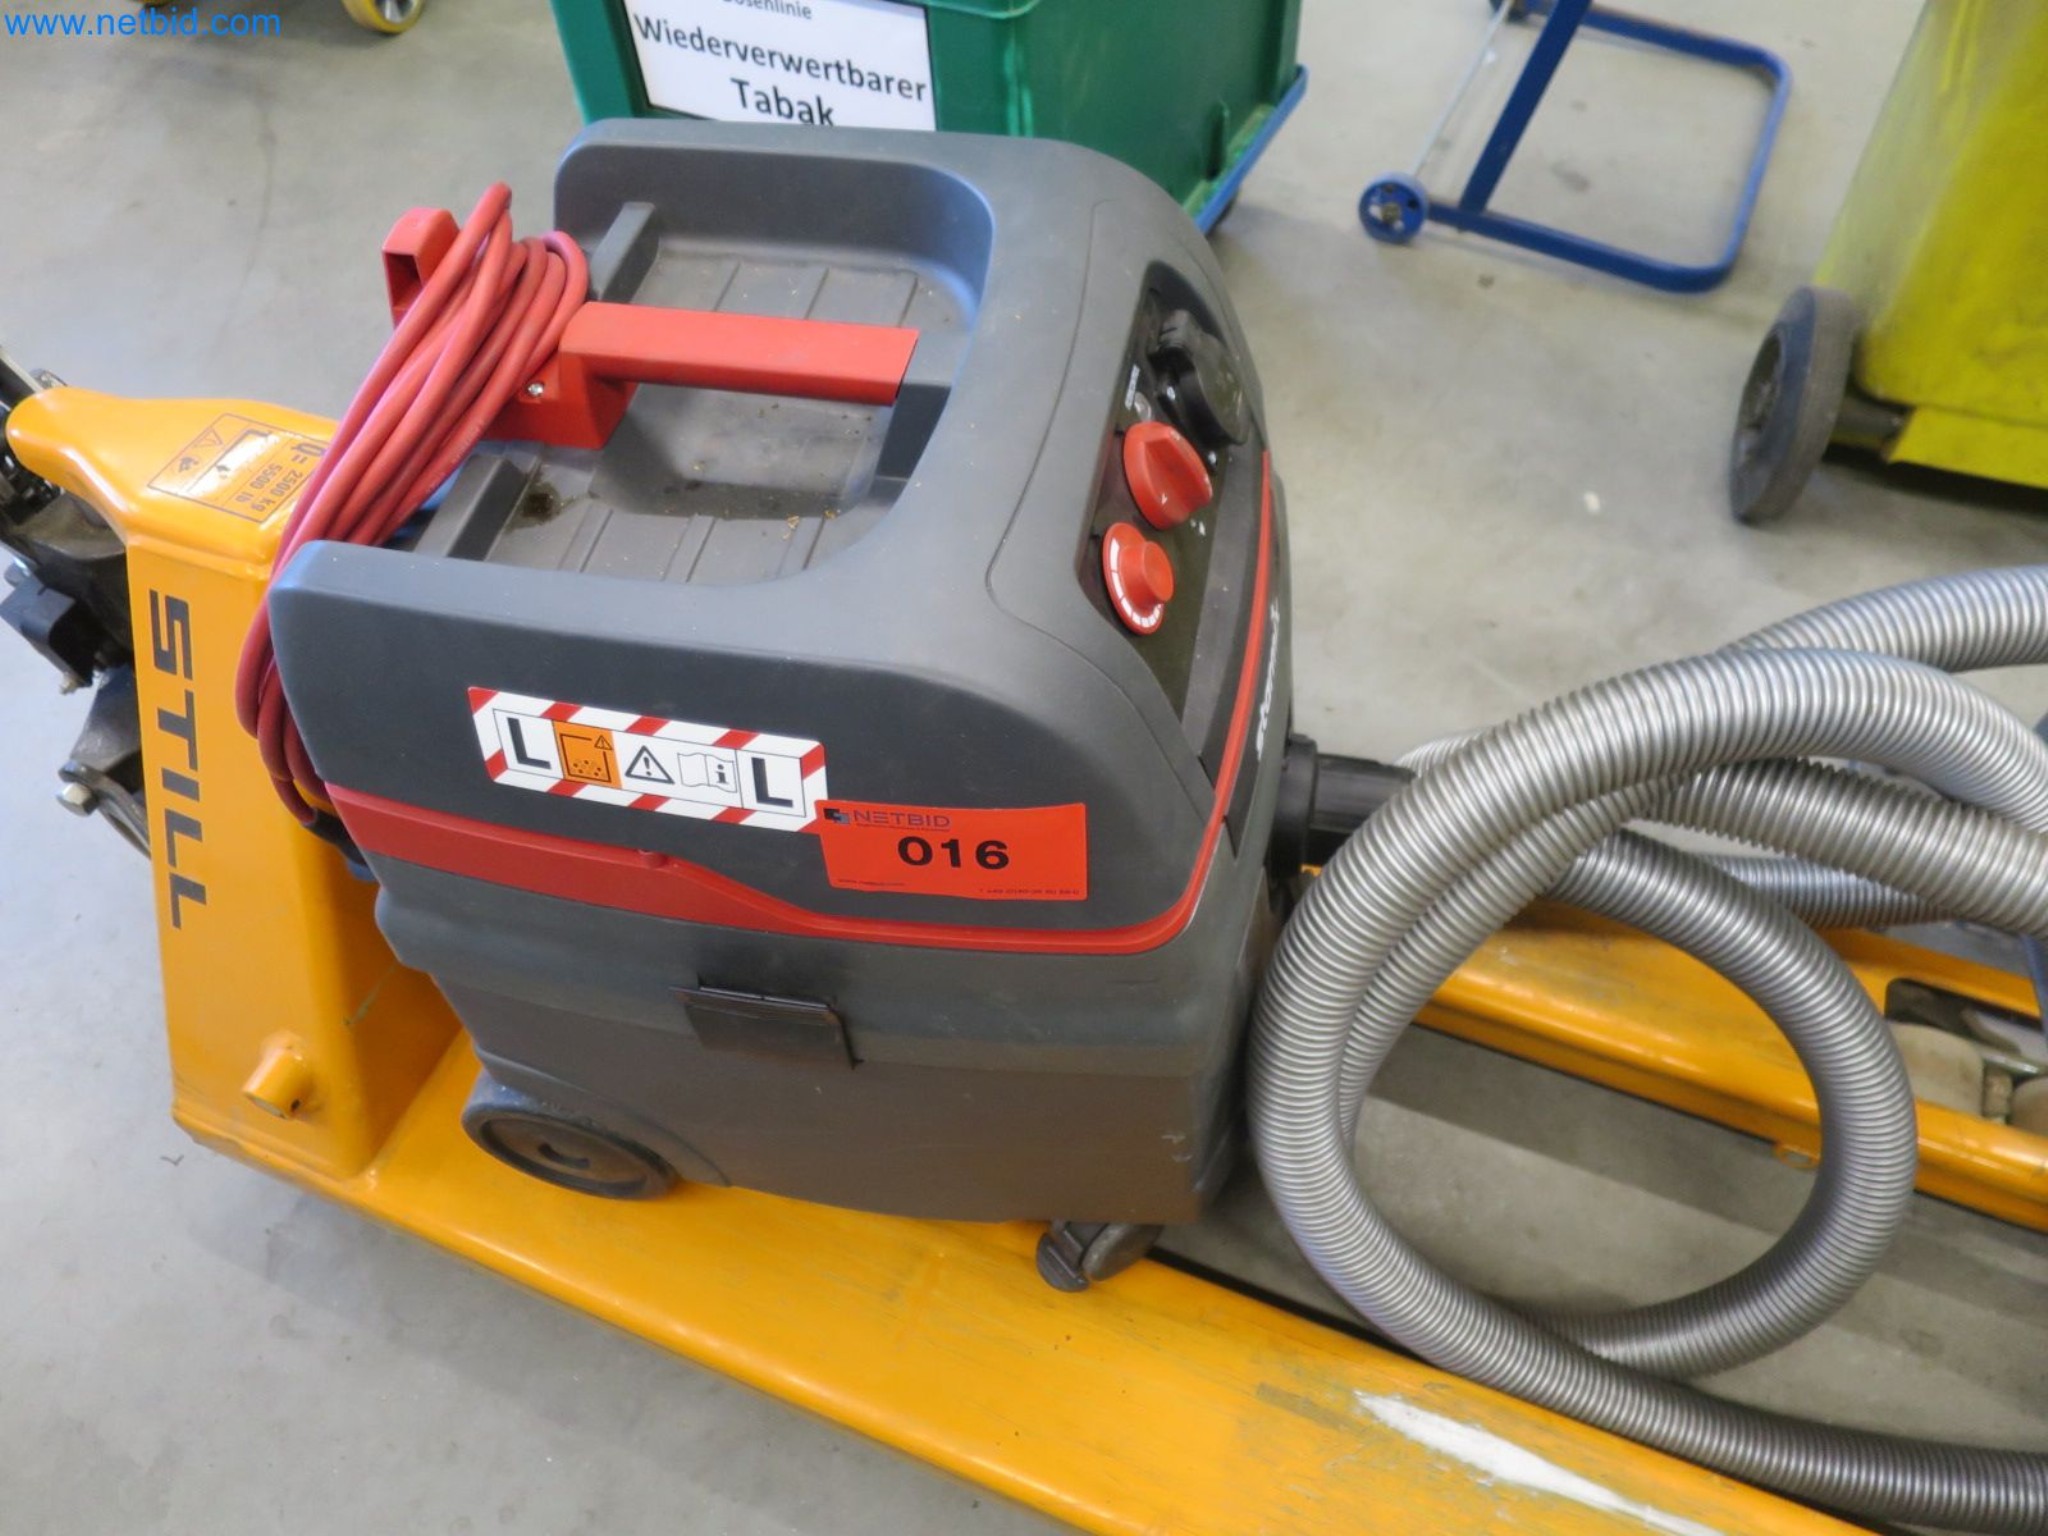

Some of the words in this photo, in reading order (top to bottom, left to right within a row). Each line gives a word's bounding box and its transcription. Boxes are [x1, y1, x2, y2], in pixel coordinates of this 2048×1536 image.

[723, 0, 812, 19] senlinie
[633, 13, 926, 101] Wiederverwertbarer
[730, 78, 834, 126] Tabak
[250, 464, 283, 490] 5500
[270, 469, 303, 497] 2500
[149, 588, 207, 930] STILL
[507, 717, 551, 770] L
[752, 757, 793, 808] L
[853, 809, 951, 828] NETBID
[898, 835, 1010, 870] 016
